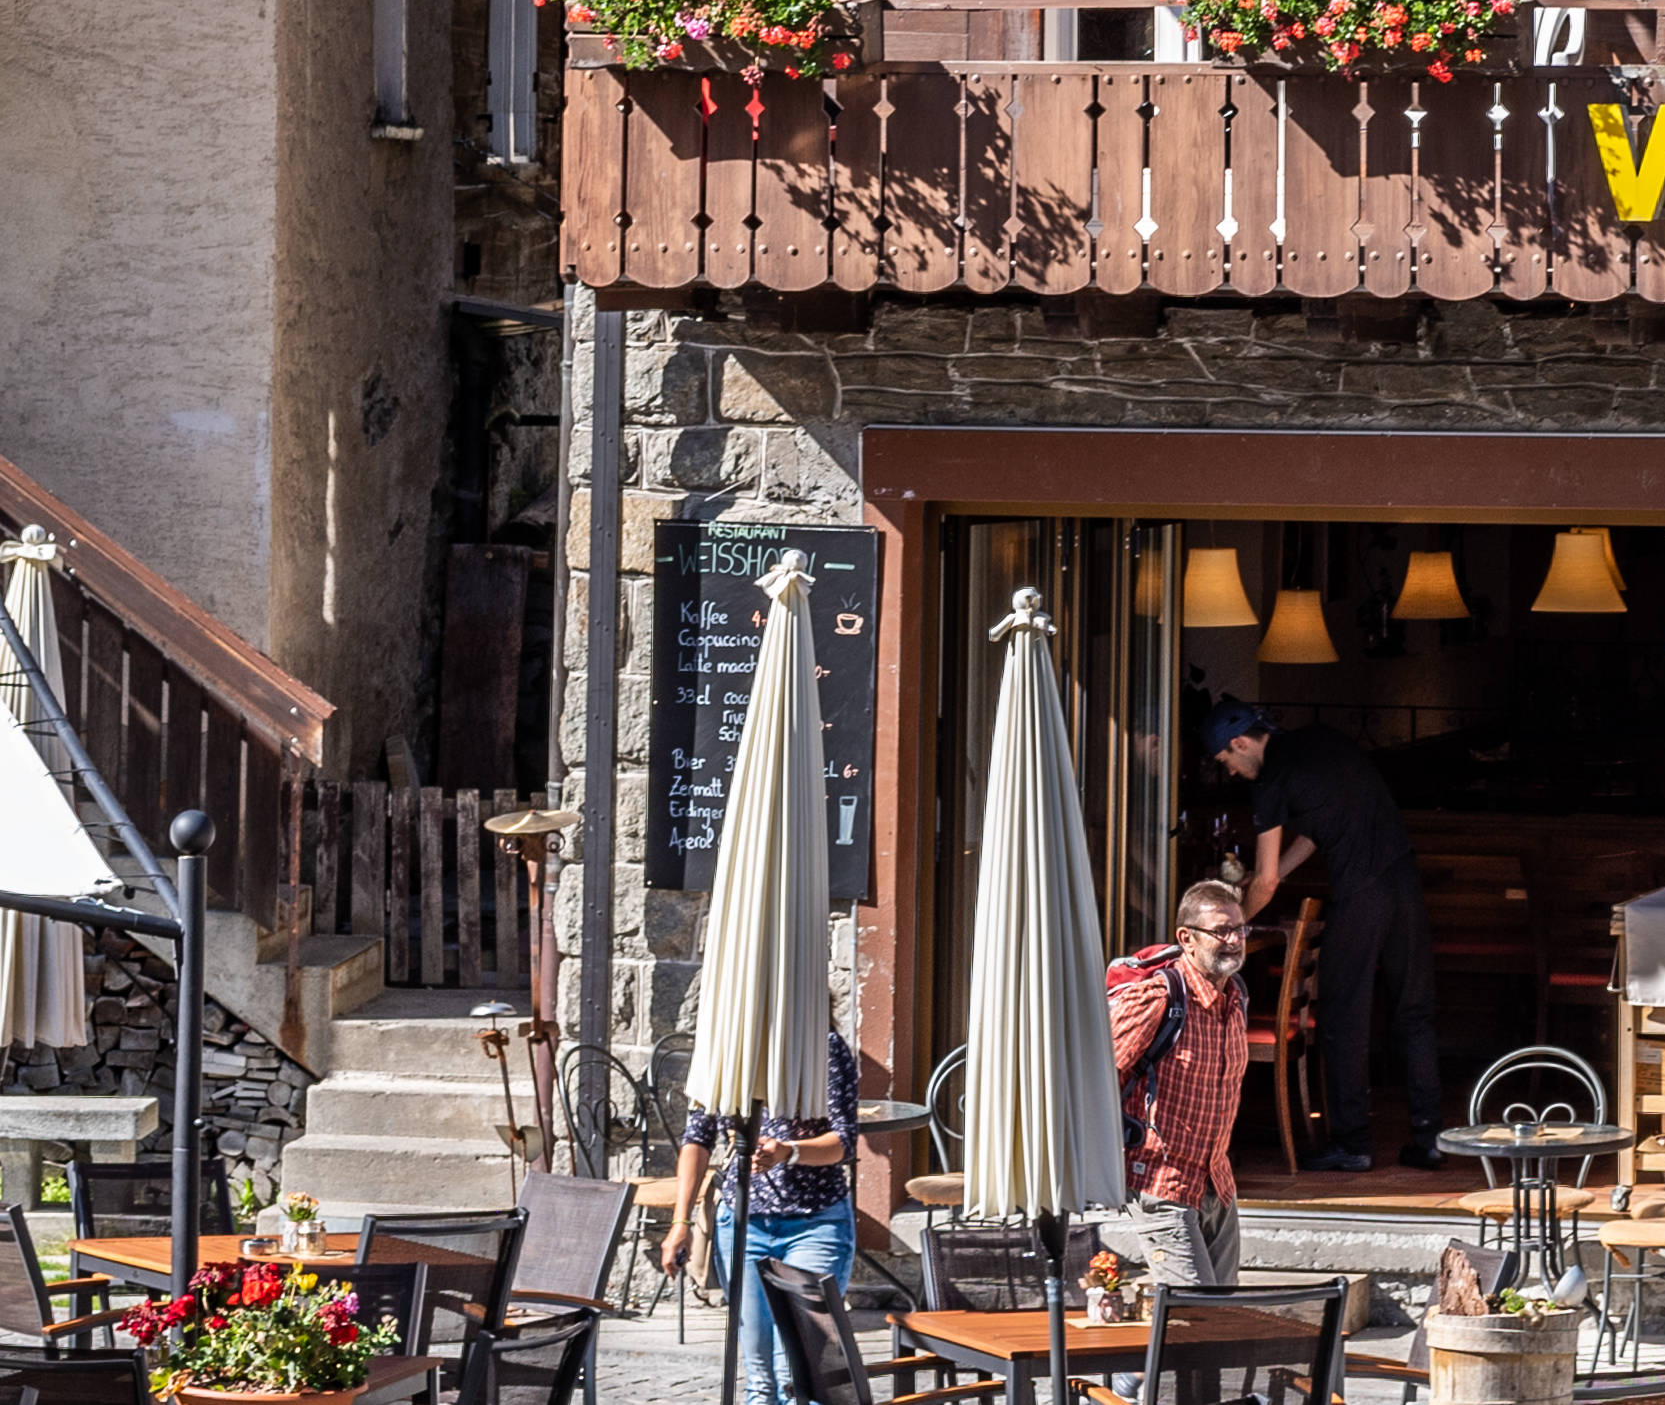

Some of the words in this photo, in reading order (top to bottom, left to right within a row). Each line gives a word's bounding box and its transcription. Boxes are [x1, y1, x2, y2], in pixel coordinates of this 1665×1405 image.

[707, 521, 788, 540] RESTAURANT
[679, 541, 816, 578] WEISSHO
[680, 600, 729, 630] Kaffee
[678, 628, 761, 658] Cappuccino
[678, 652, 713, 673] Latte
[717, 654, 758, 673] macch
[675, 684, 712, 706] 33cl
[722, 709, 747, 727] rive
[718, 724, 742, 743] Sch
[671, 748, 707, 770] Bier
[669, 776, 725, 799] Zermatt
[669, 799, 725, 830] Erdinger
[669, 826, 716, 857] Aperol
